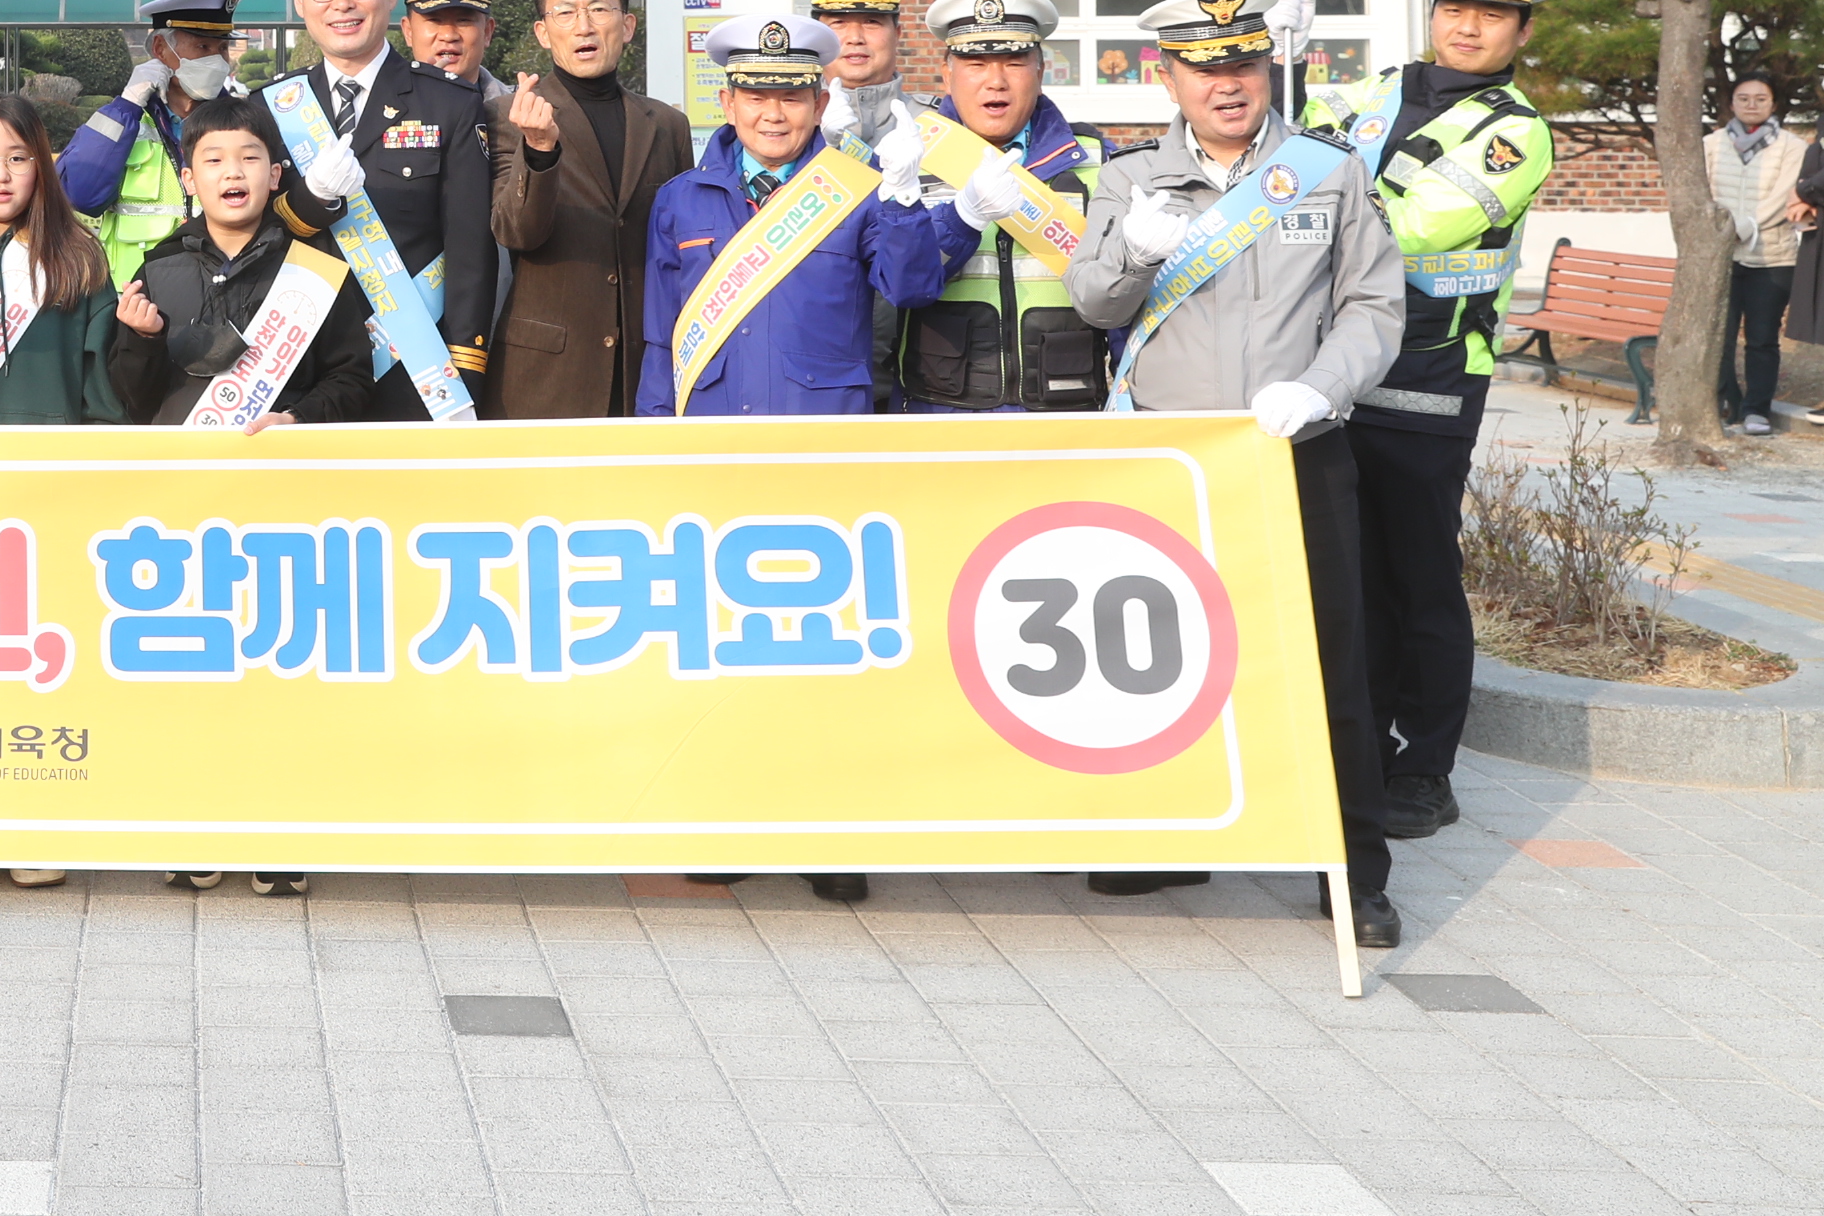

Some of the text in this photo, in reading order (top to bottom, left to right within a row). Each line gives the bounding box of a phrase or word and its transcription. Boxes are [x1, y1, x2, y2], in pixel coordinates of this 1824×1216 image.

[378, 249, 405, 277] 내
[1284, 232, 1329, 241] POLICE
[336, 225, 400, 318] 일시정지
[678, 192, 827, 368] 어린이 교통안전 함께
[231, 309, 287, 383] 안전속도
[265, 325, 309, 382] 아이가
[219, 386, 237, 403] 50
[89, 516, 393, 681] 함께
[407, 513, 912, 680] 지켜요!
[1001, 574, 1184, 698] 30
[13, 767, 89, 781] EDUCATION
